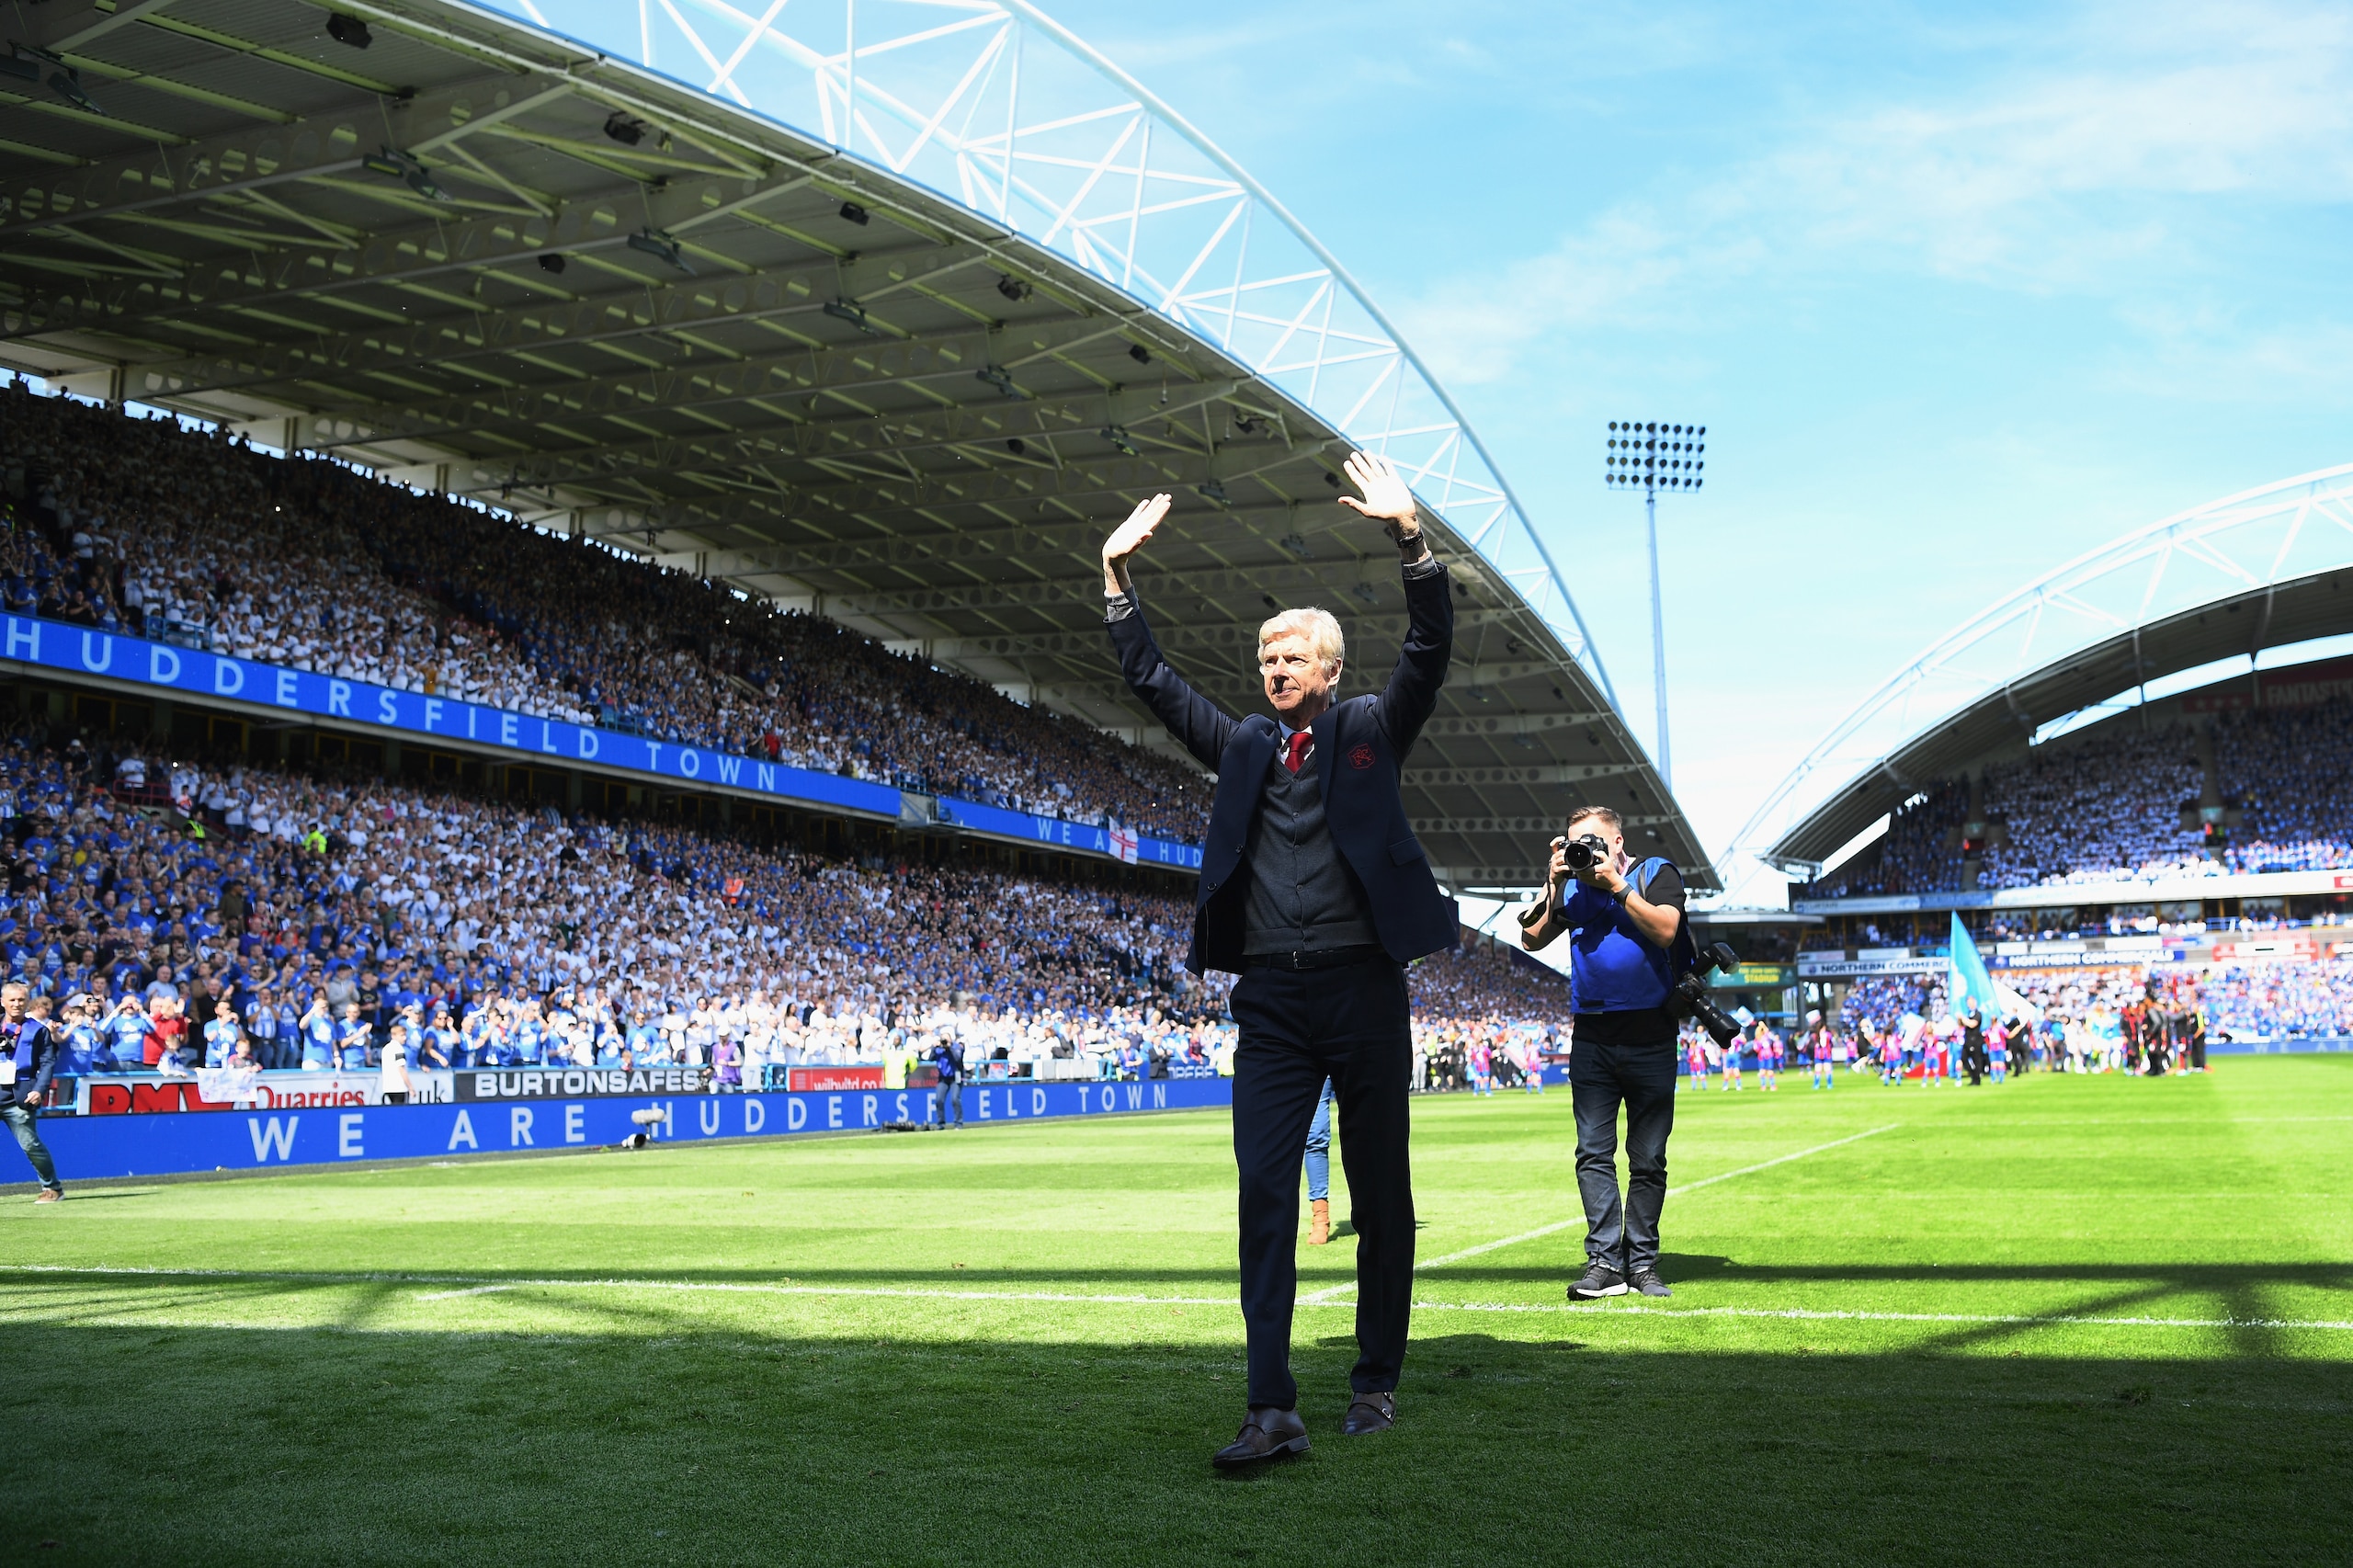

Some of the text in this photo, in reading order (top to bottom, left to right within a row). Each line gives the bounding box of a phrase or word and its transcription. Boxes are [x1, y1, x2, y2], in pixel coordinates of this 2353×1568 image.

[6, 618, 775, 792] HUDDERSFIELD TOWN
[1038, 817, 1071, 845] WE
[1821, 960, 1945, 973] NORTHERN COMMERC
[2009, 953, 2081, 968] NORTHERN
[253, 1083, 365, 1108] Quarries
[474, 1071, 699, 1097] BURTONSAFES
[248, 1084, 1165, 1162] WE ARE HUDDERSFELD TOWN
